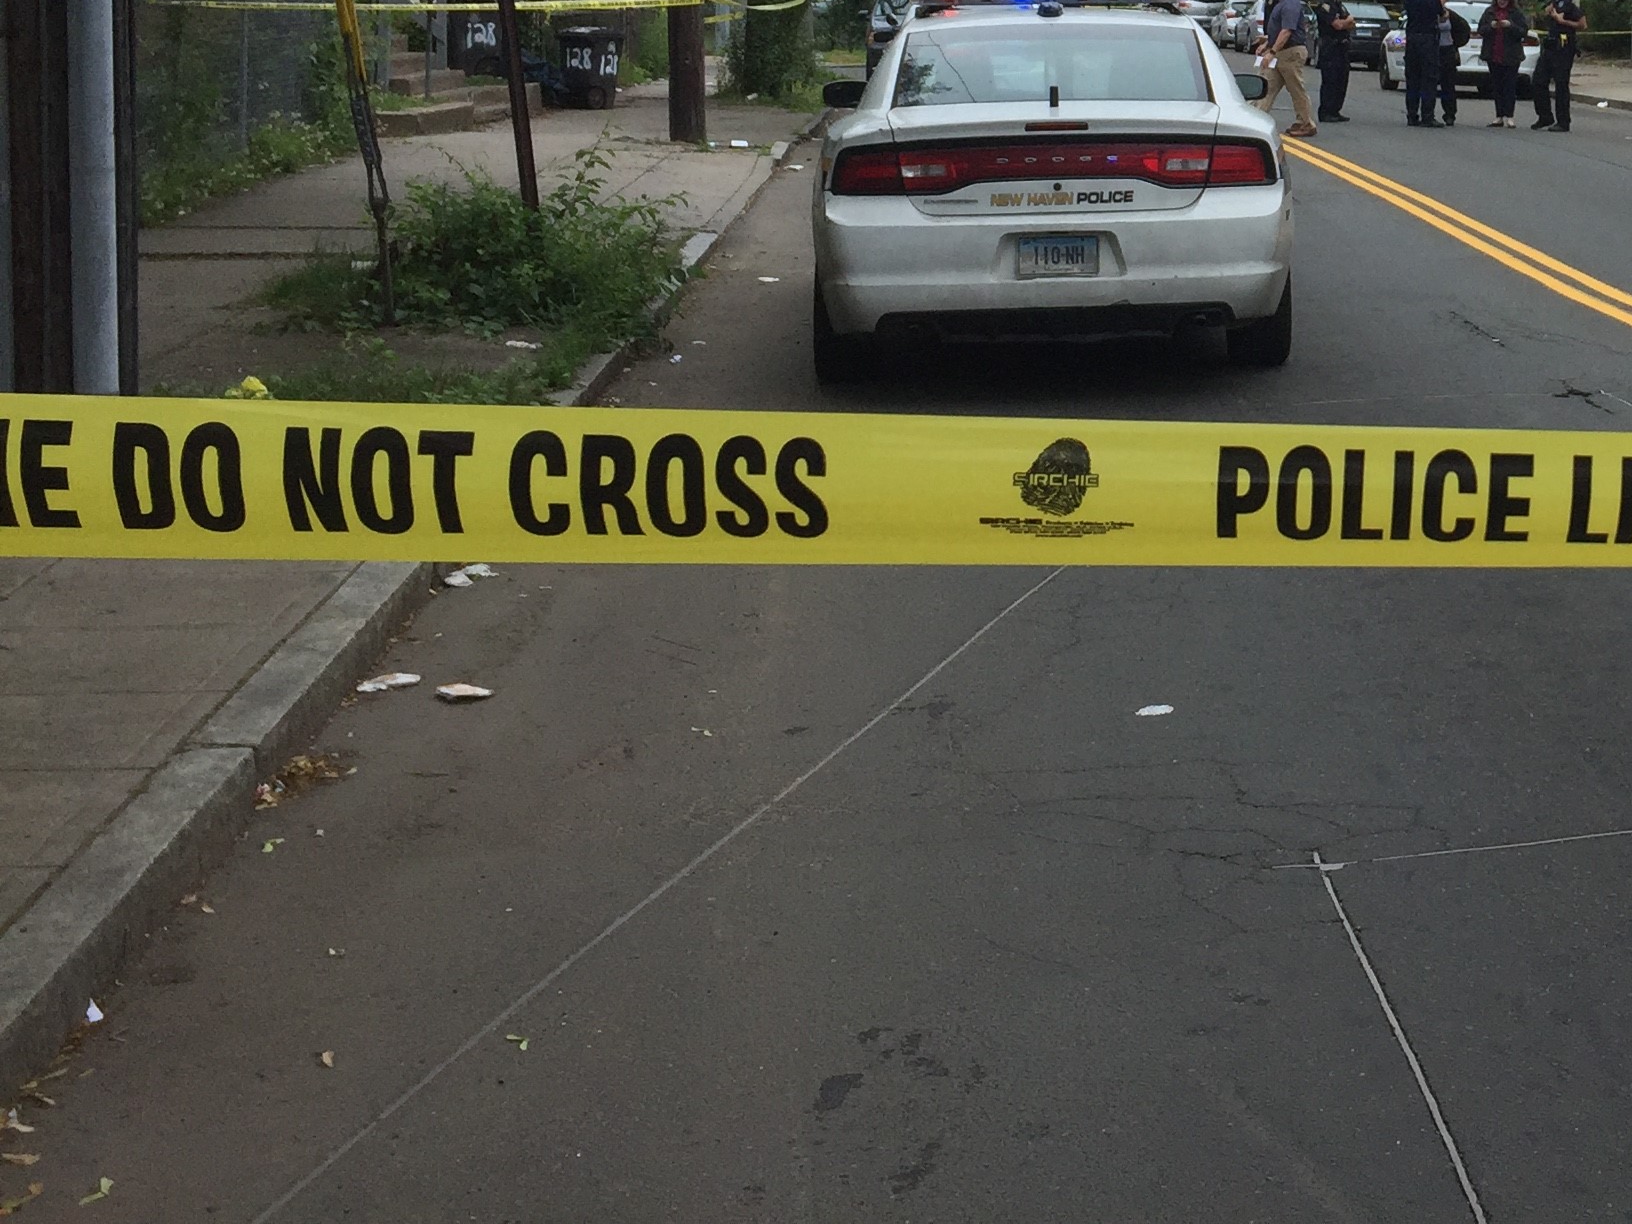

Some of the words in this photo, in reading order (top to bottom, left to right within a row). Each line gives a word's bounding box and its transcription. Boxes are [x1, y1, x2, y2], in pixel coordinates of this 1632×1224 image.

[466, 22, 496, 49] 128
[566, 47, 592, 70] 128
[990, 193, 1024, 207] NEW
[1027, 191, 1074, 206] HAVEN
[1077, 190, 1134, 204] POLICE
[112, 420, 247, 533] DO
[282, 426, 474, 535] NOT
[508, 429, 830, 539] CROSS
[1013, 472, 1099, 487] SIRCHIE
[1216, 444, 1534, 542] POLICE
